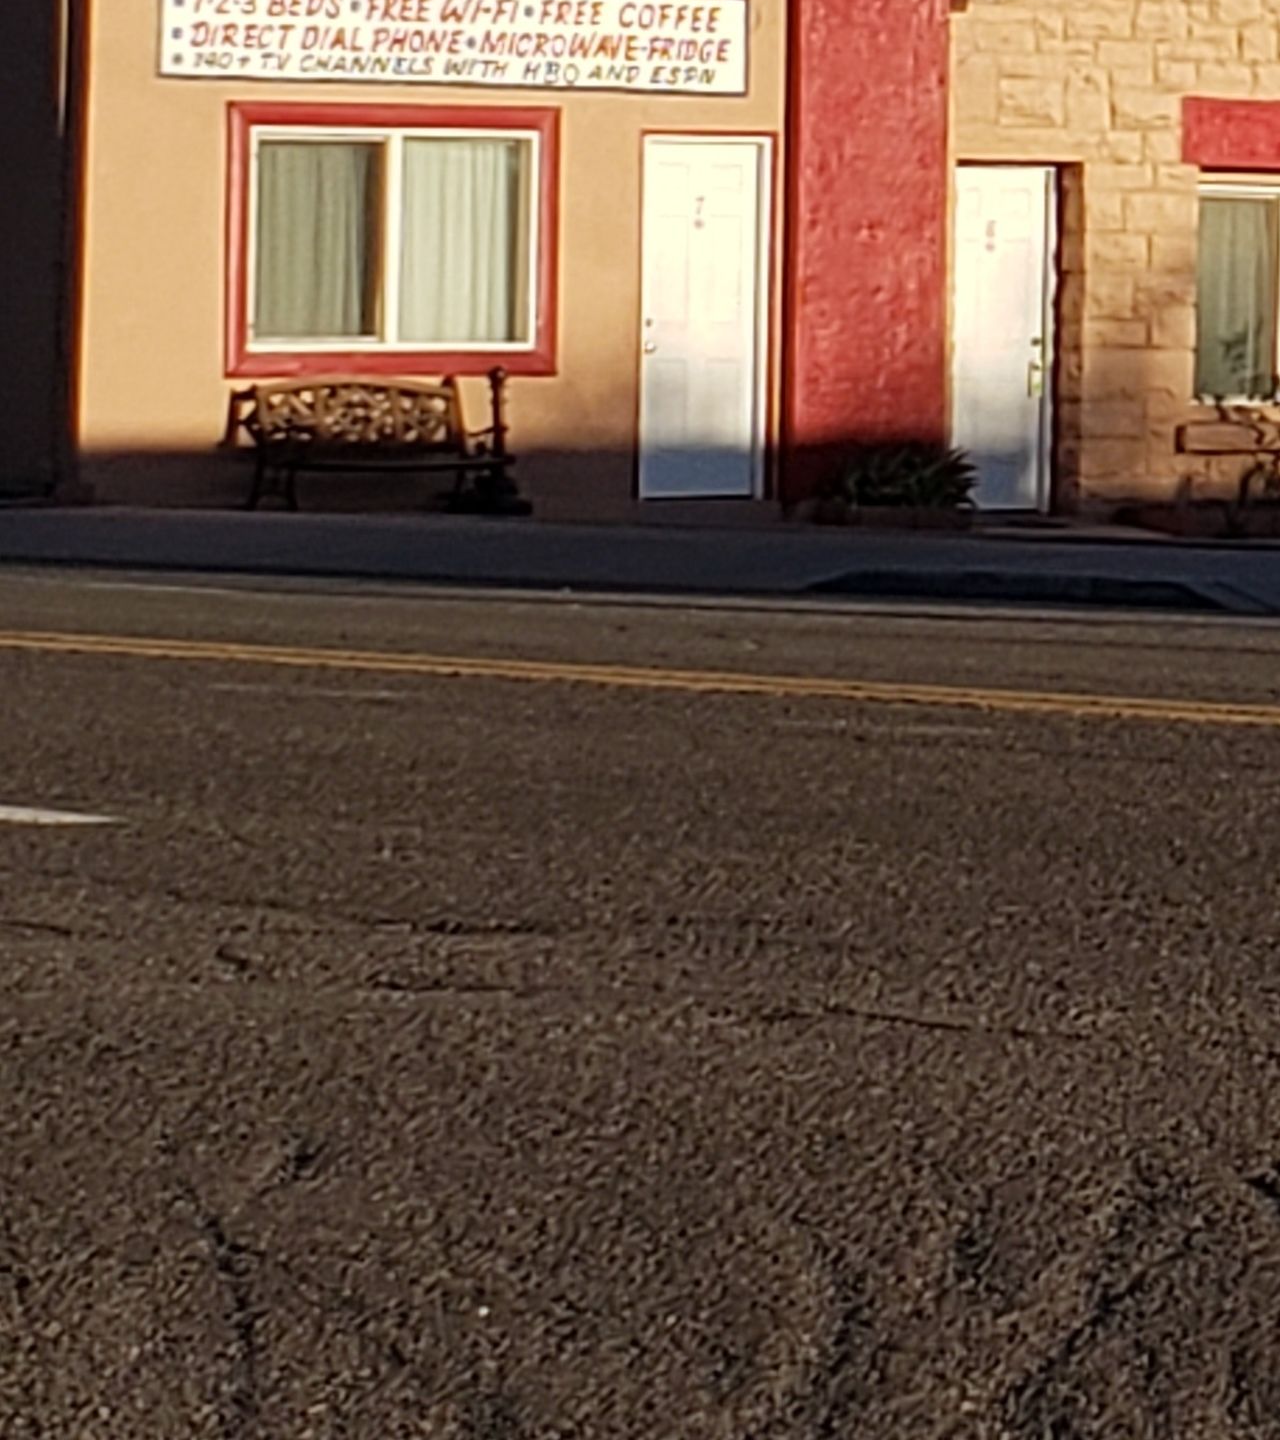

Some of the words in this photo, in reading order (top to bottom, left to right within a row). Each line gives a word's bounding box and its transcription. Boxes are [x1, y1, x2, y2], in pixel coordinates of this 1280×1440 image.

[539, 0, 604, 26] FREE
[618, 3, 721, 33] COFFEE
[190, 21, 294, 49] DIRECT
[300, 25, 363, 51] DIAL
[370, 28, 464, 55] PHONE
[299, 55, 434, 75] CHANNELS
[443, 58, 508, 78] WITH
[522, 60, 580, 84] HBO
[587, 64, 641, 82] AND
[648, 65, 716, 85] ESPN
